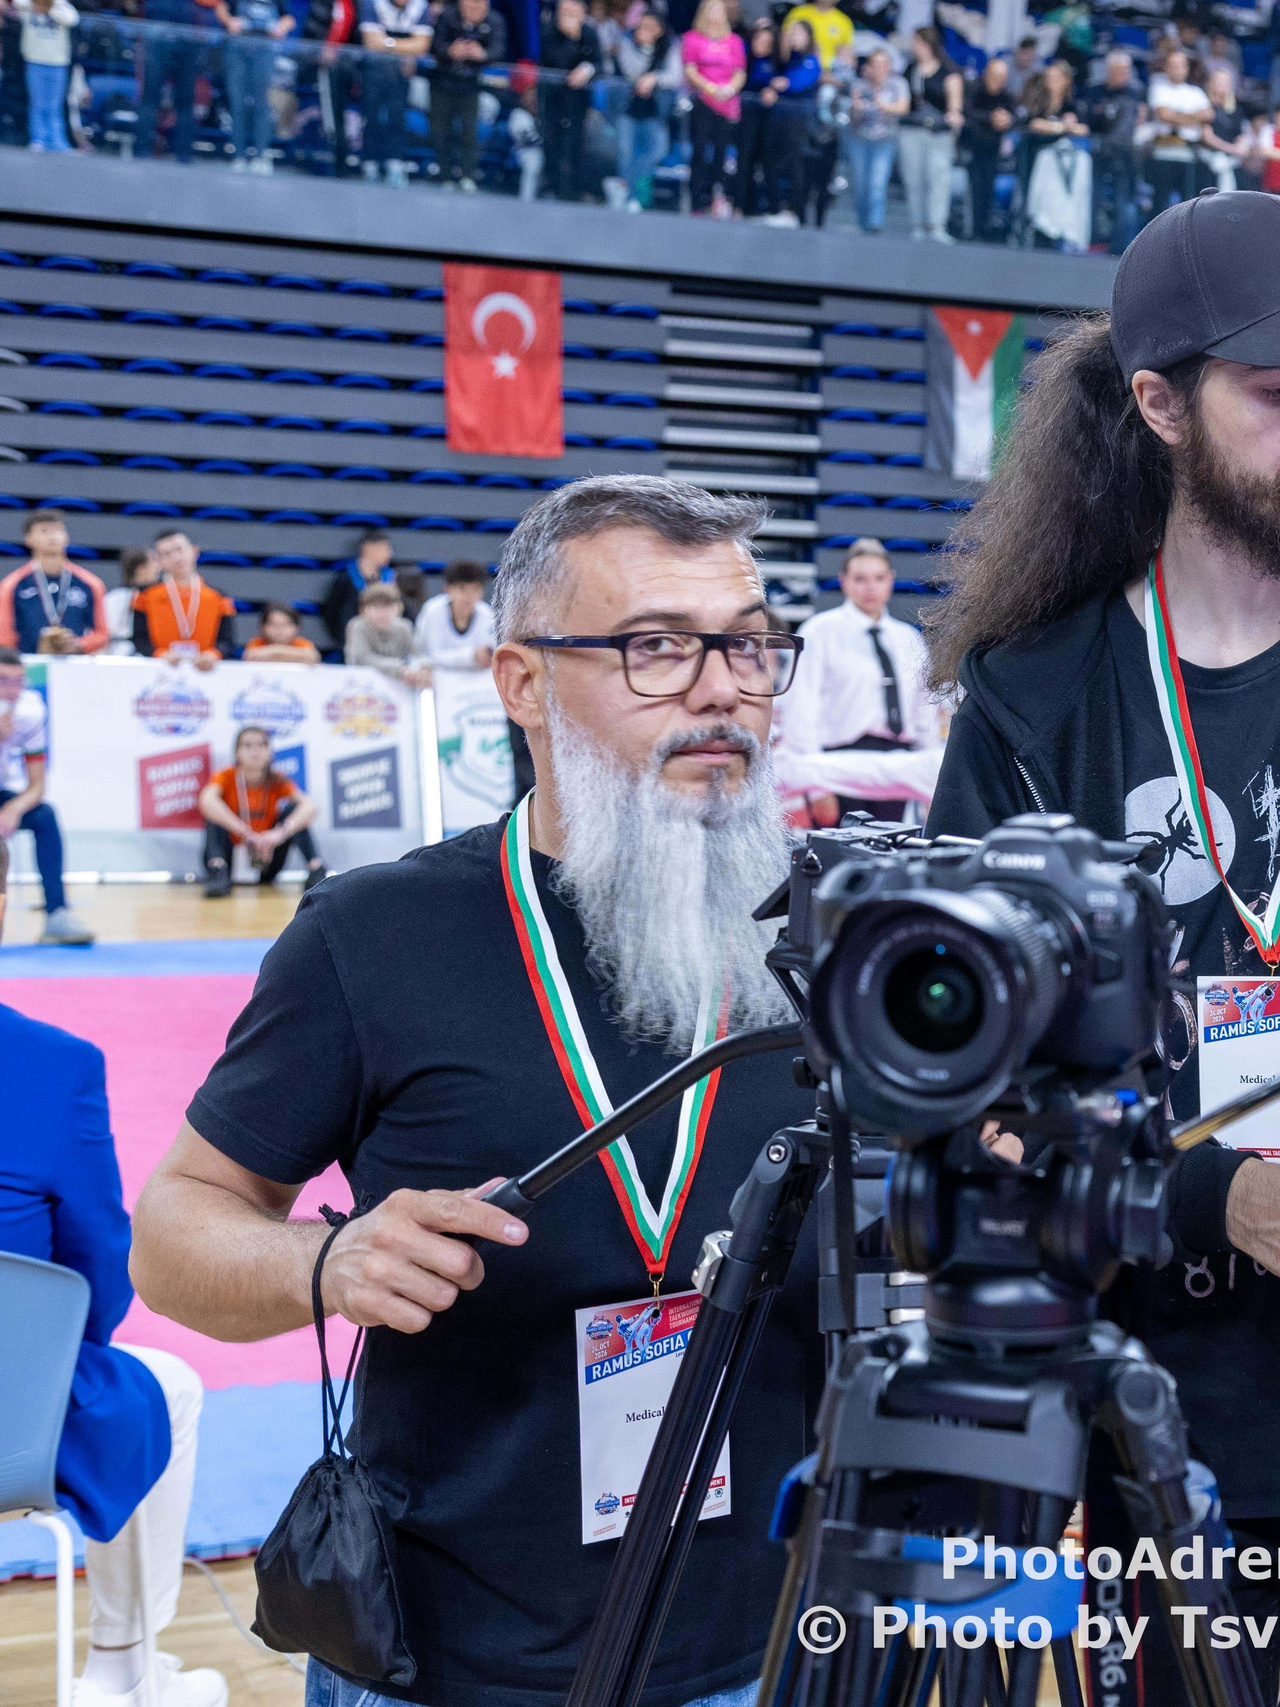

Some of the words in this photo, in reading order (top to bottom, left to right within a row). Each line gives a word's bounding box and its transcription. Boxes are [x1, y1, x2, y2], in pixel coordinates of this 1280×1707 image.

[983, 849, 1046, 871] Canon
[1210, 1021, 1255, 1040] RAMUS
[669, 1306, 700, 1322] TAEKWONDO
[592, 1351, 641, 1380] RAMUS
[645, 1335, 685, 1360] SOFIA
[625, 1406, 665, 1423] Medical
